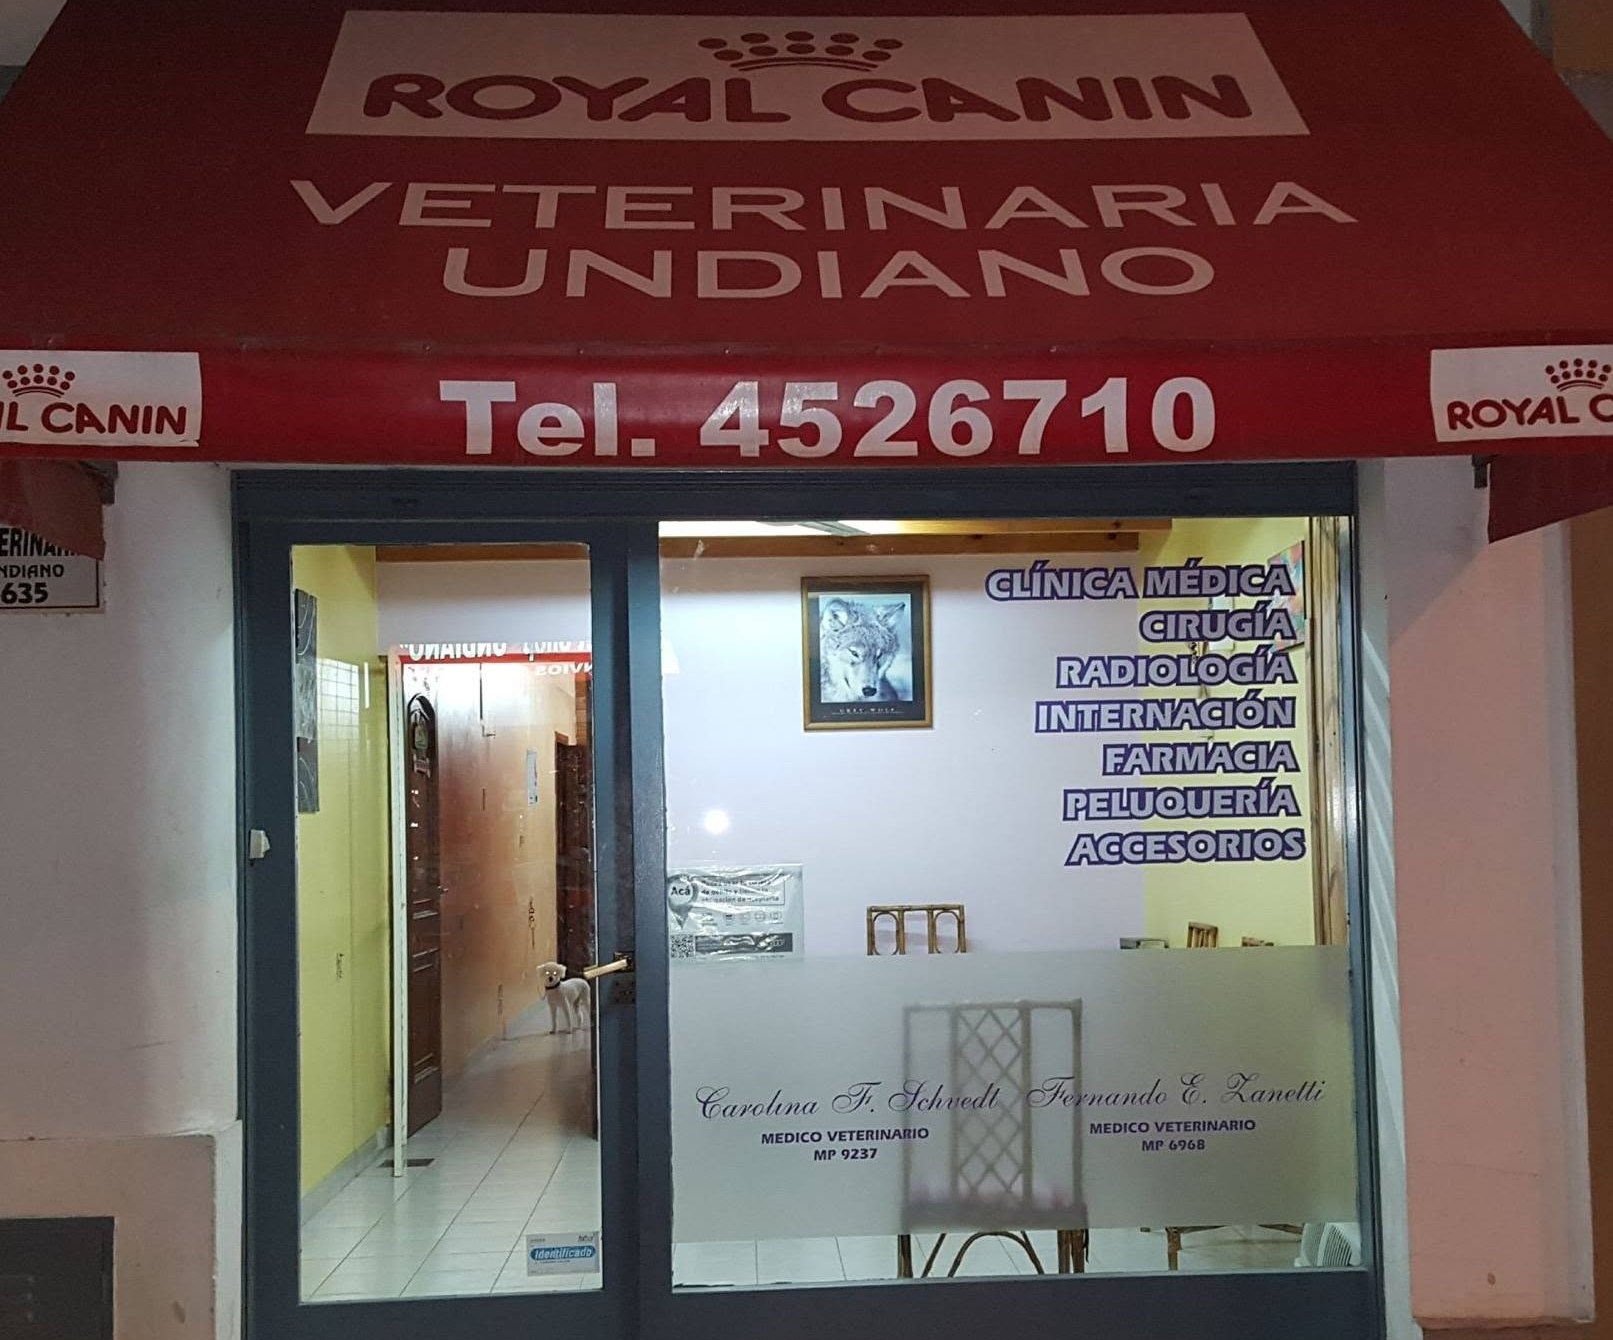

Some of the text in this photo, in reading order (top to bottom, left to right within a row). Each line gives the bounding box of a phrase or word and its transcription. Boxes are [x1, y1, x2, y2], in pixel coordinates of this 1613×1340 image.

[363, 73, 1252, 123] ROYAL CANIN
[290, 180, 1358, 231] VETERINARIA
[442, 246, 1215, 299] UNDIANO
[41, 402, 187, 435] CANIN
[439, 377, 1216, 458] Tel. 4526710
[1447, 396, 1580, 430] ROYAL
[1, 582, 48, 603] 635
[985, 558, 1296, 600] CLÍNICA MÉDICA
[1139, 600, 1296, 642] CIRUGÍA
[1056, 644, 1298, 688] RADIOLOGÍA
[1035, 689, 1296, 733] INTERNACIÓN
[1102, 741, 1300, 775] FARMACIA
[1062, 777, 1301, 821] PELUQUERÍA
[1065, 828, 1306, 866] ACCESORIOS
[670, 885, 690, 896] Acá
[696, 1086, 820, 1119] Carolina
[831, 1081, 881, 1113] F.
[1026, 1072, 1327, 1108] Fernando E. Zanetti
[761, 1128, 929, 1145] MEDICO VETERINARIO
[1089, 1119, 1256, 1135] MEDICO VETERINARIO
[1141, 1139, 1206, 1152] MP 6968
[813, 1148, 878, 1162] MP 9237
[535, 1248, 592, 1260] Identificado
